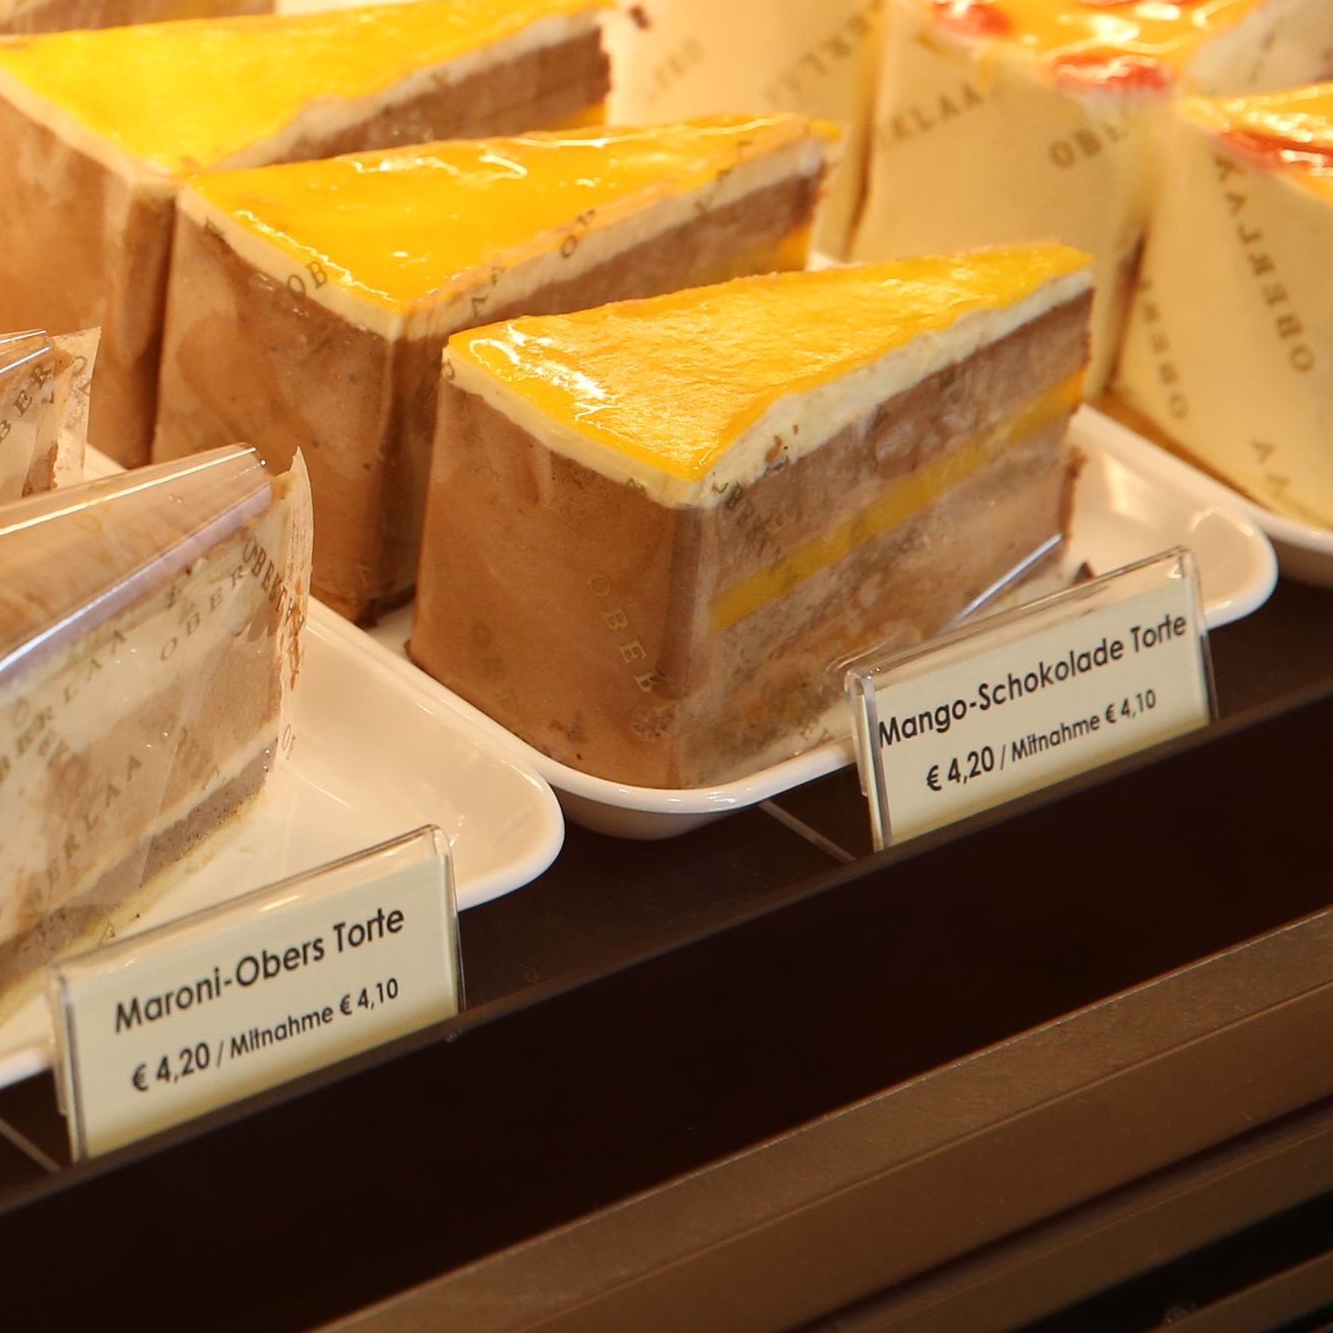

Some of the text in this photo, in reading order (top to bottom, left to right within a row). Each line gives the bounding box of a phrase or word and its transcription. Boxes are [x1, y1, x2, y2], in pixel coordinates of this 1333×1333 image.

[160, 564, 244, 662] OBER
[879, 612, 1188, 748] Mango-Schokolade Torte
[926, 765, 943, 792] €
[947, 744, 995, 786] 4,20
[1011, 712, 1102, 763] Mitnahme
[1105, 703, 1116, 725] €
[1119, 687, 1157, 720] 4,10
[114, 905, 405, 1035] Maroni-Obers Torte
[131, 1063, 150, 1093] €
[155, 1041, 210, 1087] 4,20
[229, 1004, 335, 1060] Mitnahme
[339, 993, 353, 1017] €
[357, 977, 400, 1012] 4,10
